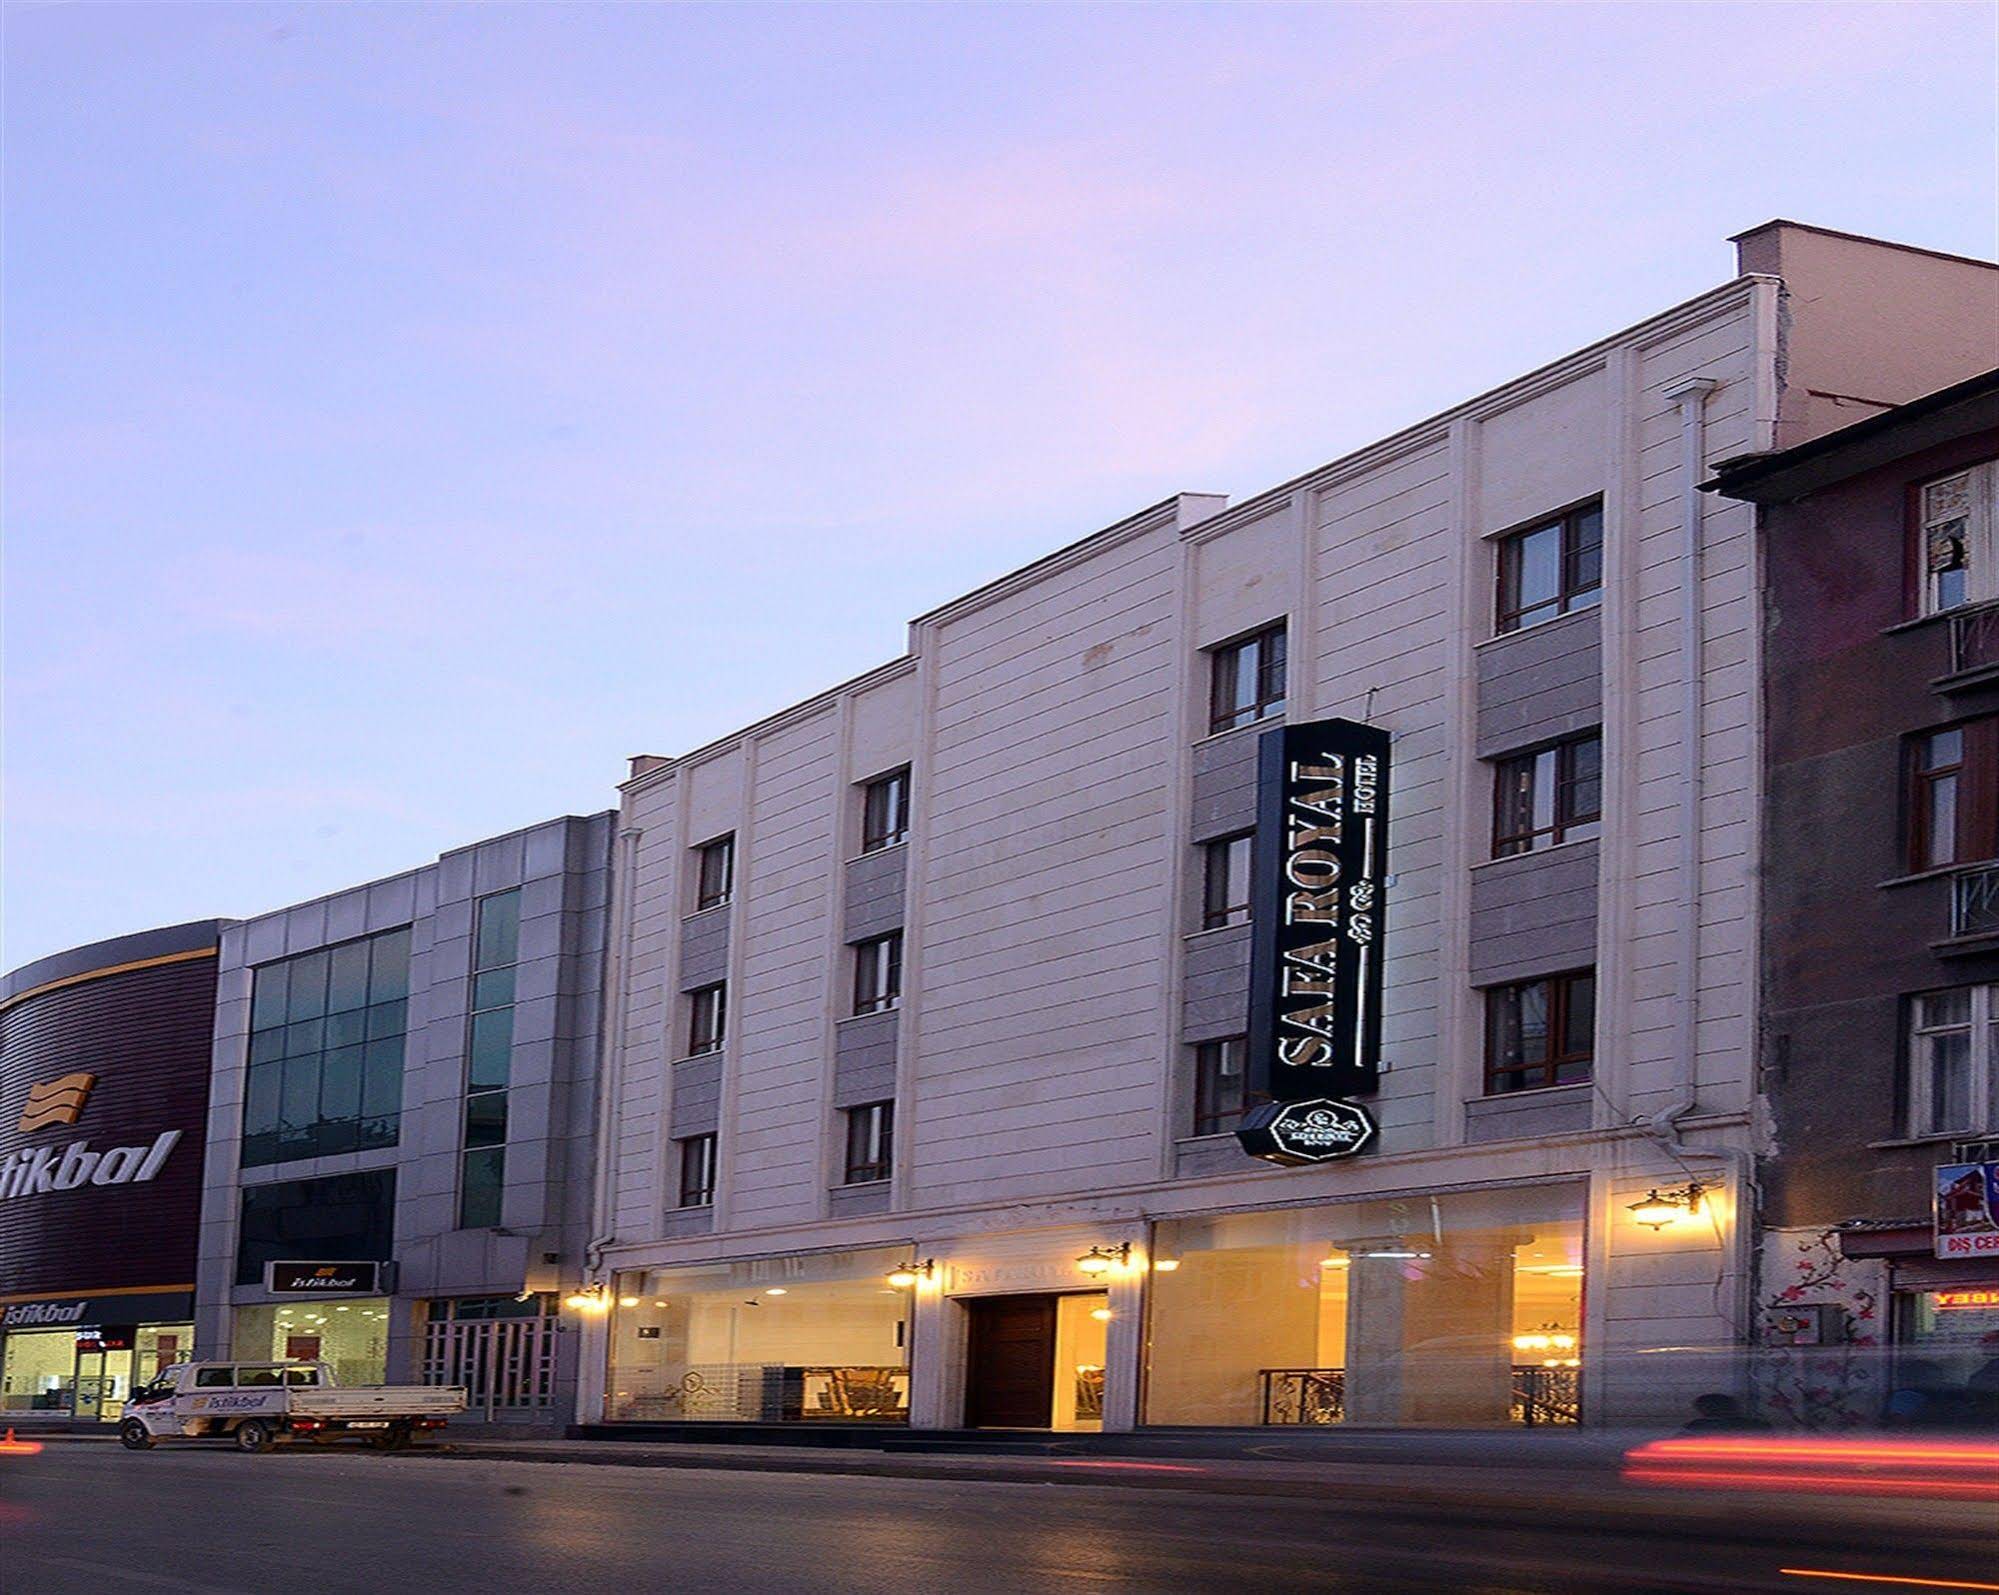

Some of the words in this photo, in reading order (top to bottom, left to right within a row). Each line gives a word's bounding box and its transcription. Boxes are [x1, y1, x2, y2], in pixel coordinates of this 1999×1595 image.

[1285, 751, 1345, 928] ROYAL
[1353, 753, 1377, 814] HOTEL
[1277, 937, 1337, 1067] SAFA
